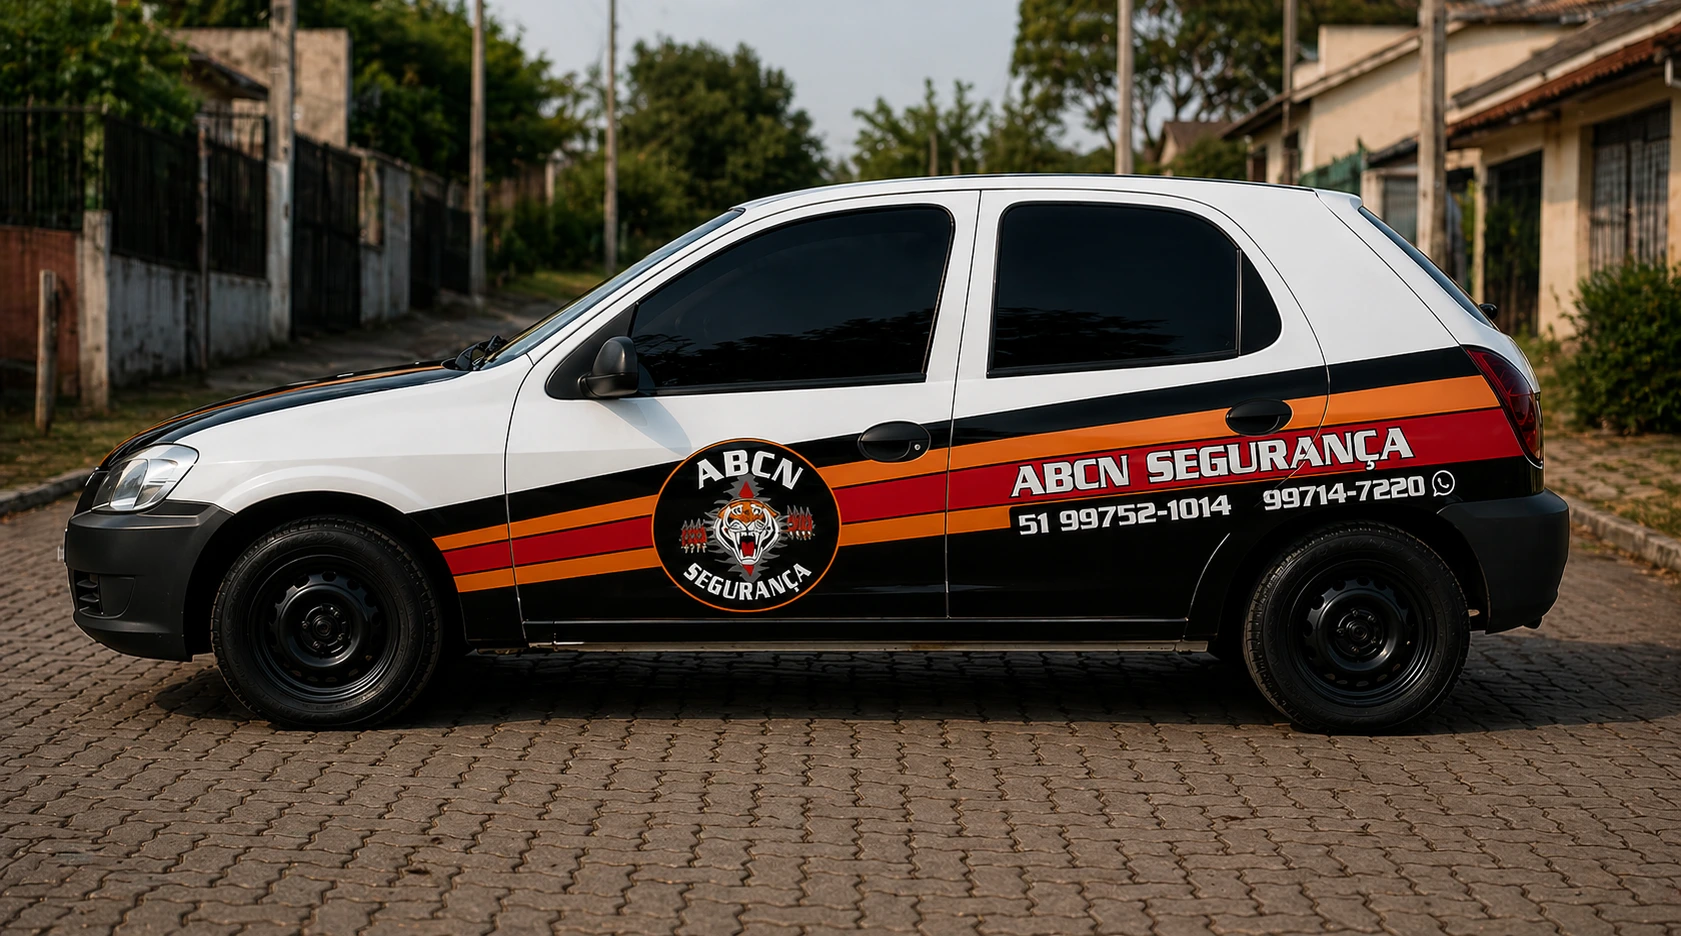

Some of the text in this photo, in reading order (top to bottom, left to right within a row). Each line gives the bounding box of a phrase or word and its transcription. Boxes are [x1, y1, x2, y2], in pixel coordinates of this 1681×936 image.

[696, 449, 804, 490] ABCN
[1010, 427, 1415, 497] ABCN SEGURANÇA
[1018, 475, 1426, 535] 51 99752-1014 99714-7220
[683, 562, 812, 601] SEGURANÇA
